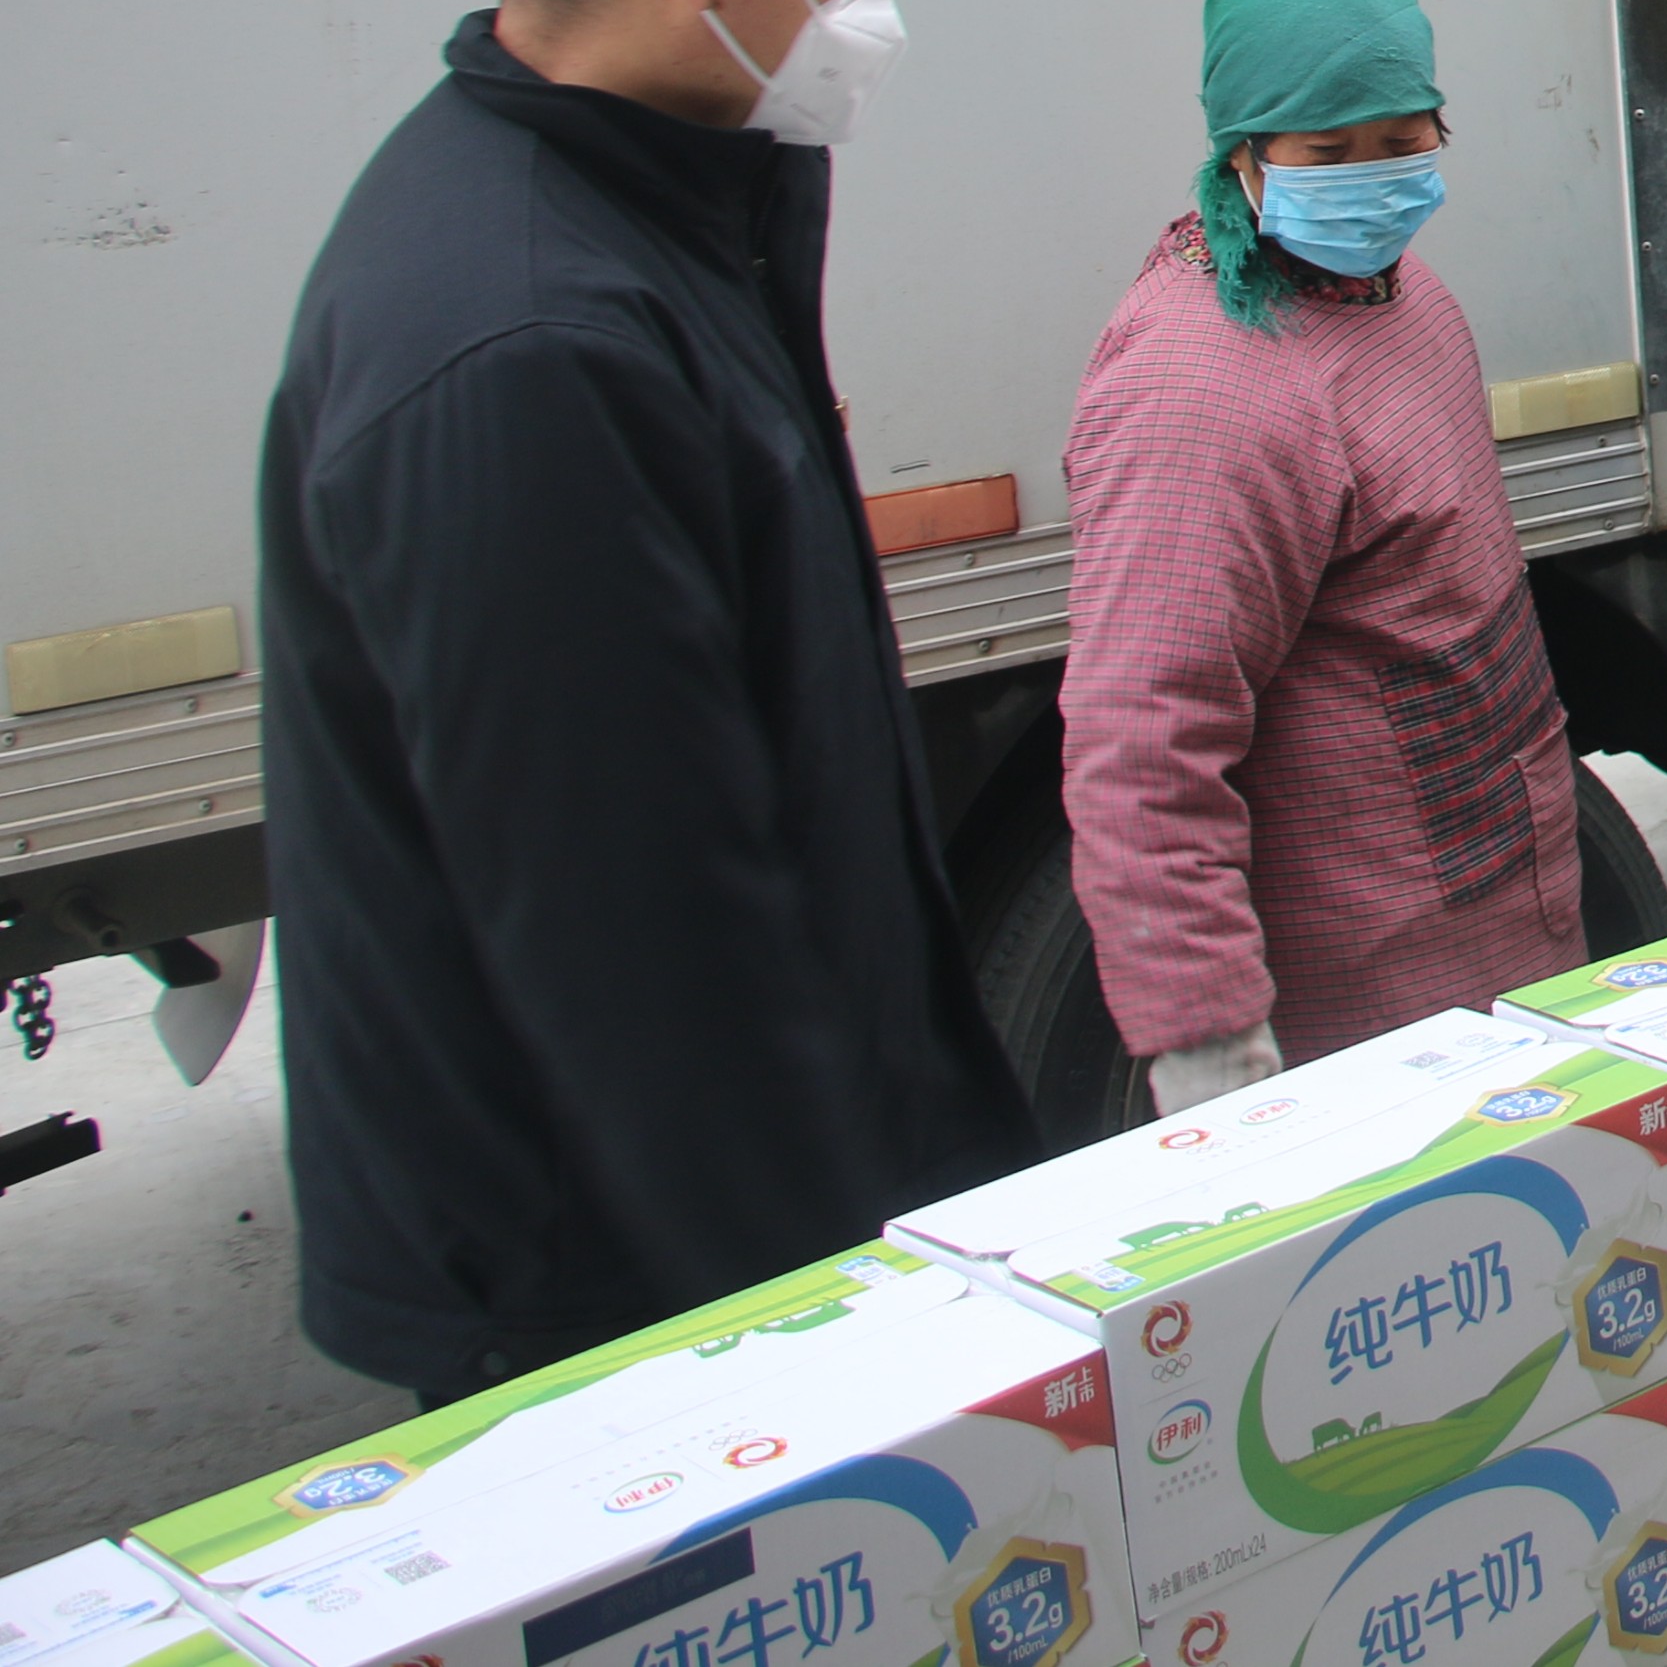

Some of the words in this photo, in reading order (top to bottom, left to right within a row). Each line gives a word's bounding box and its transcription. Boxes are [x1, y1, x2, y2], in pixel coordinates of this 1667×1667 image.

[1496, 1095, 1557, 1117] 3.2g
[1597, 1266, 1647, 1299] 优质乳蛋白
[1325, 1240, 1513, 1385] 纯牛奶
[1599, 1288, 1656, 1339] 3.2g
[1612, 1331, 1645, 1351] /100mL
[1156, 1412, 1202, 1452] 伊利
[304, 1467, 386, 1498] 3.2g
[987, 1566, 1052, 1608] 优质乳蛋白
[1358, 1531, 1544, 1667] 纯牛奶
[988, 1590, 1064, 1652] 3.2g
[1007, 1635, 1048, 1664] /100mL
